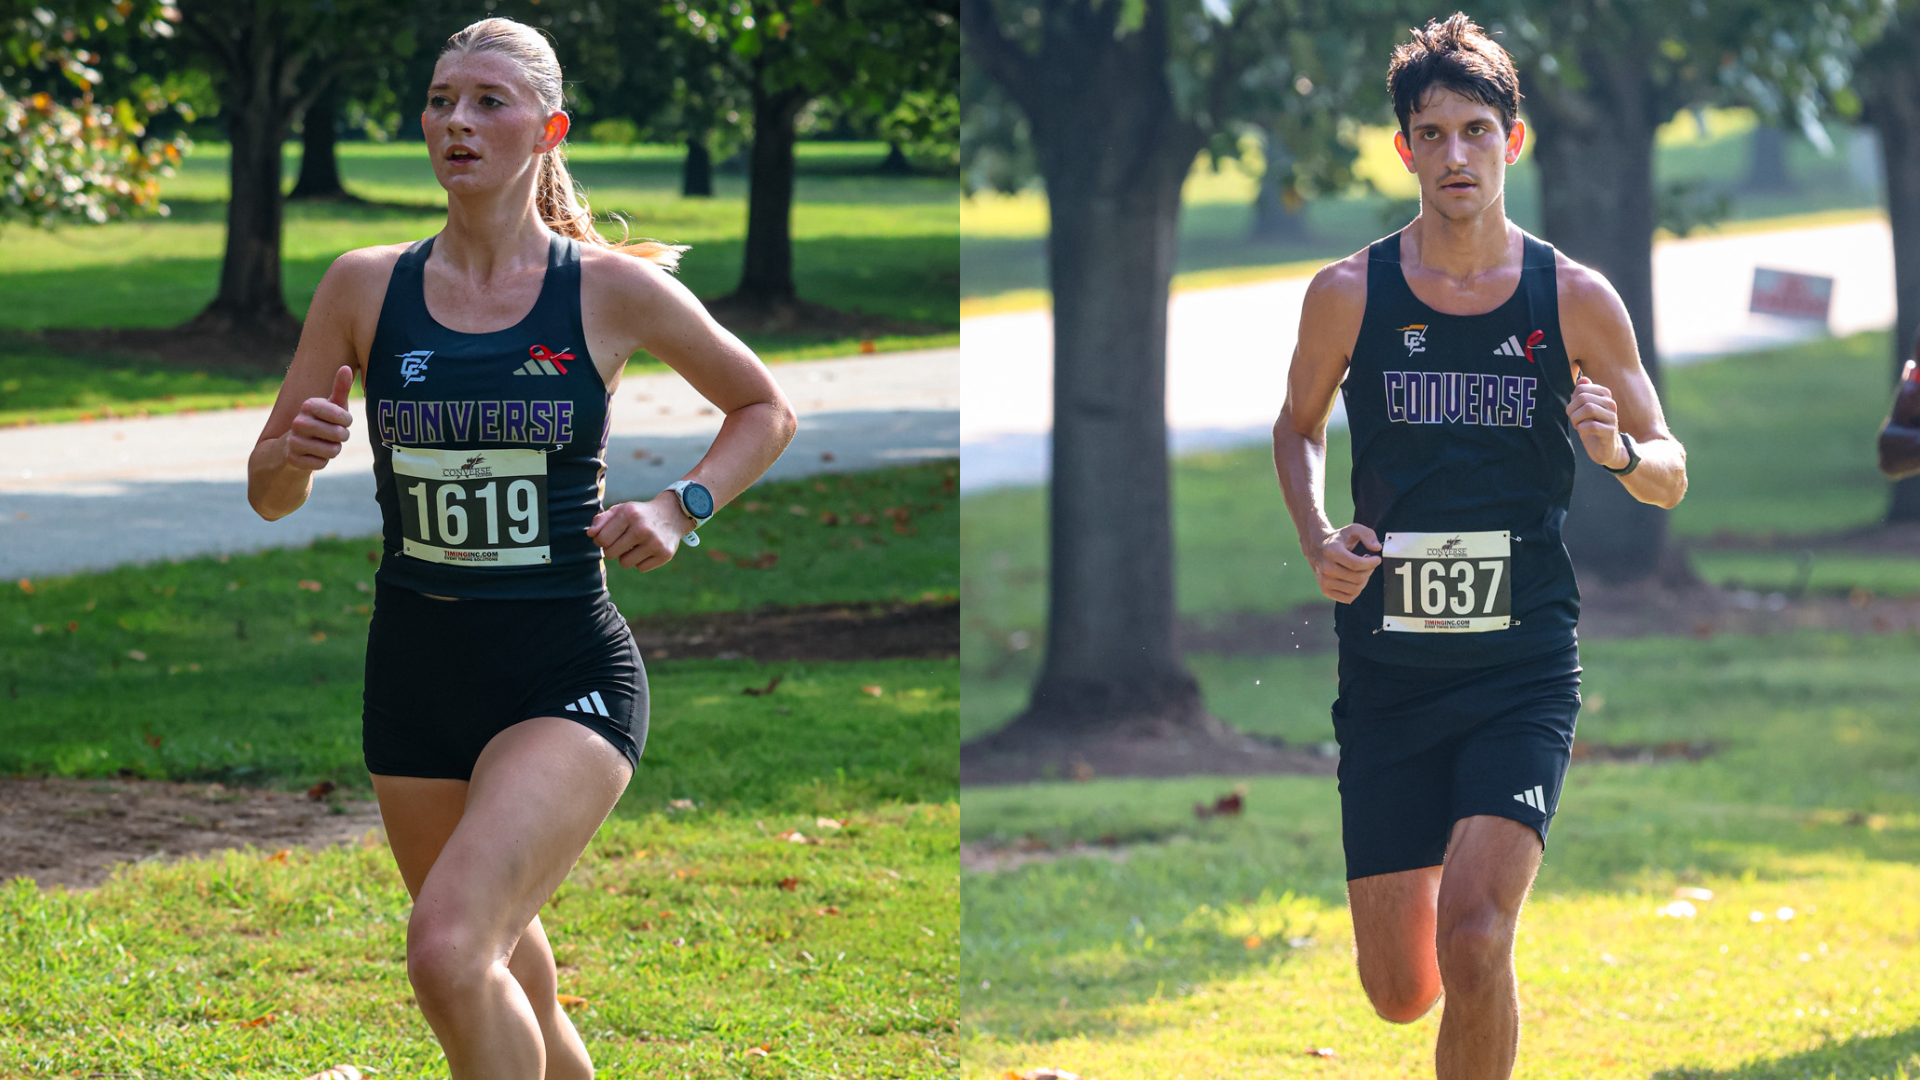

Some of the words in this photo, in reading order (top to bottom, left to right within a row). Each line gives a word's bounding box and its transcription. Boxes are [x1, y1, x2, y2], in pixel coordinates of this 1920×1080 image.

[378, 399, 574, 444] CONVERSE
[1383, 371, 1537, 428] CONVERSE
[442, 467, 491, 477] CONVERSE
[408, 479, 540, 545] 1619
[1426, 548, 1467, 556] CONVERSE
[1394, 560, 1504, 615] 1637
